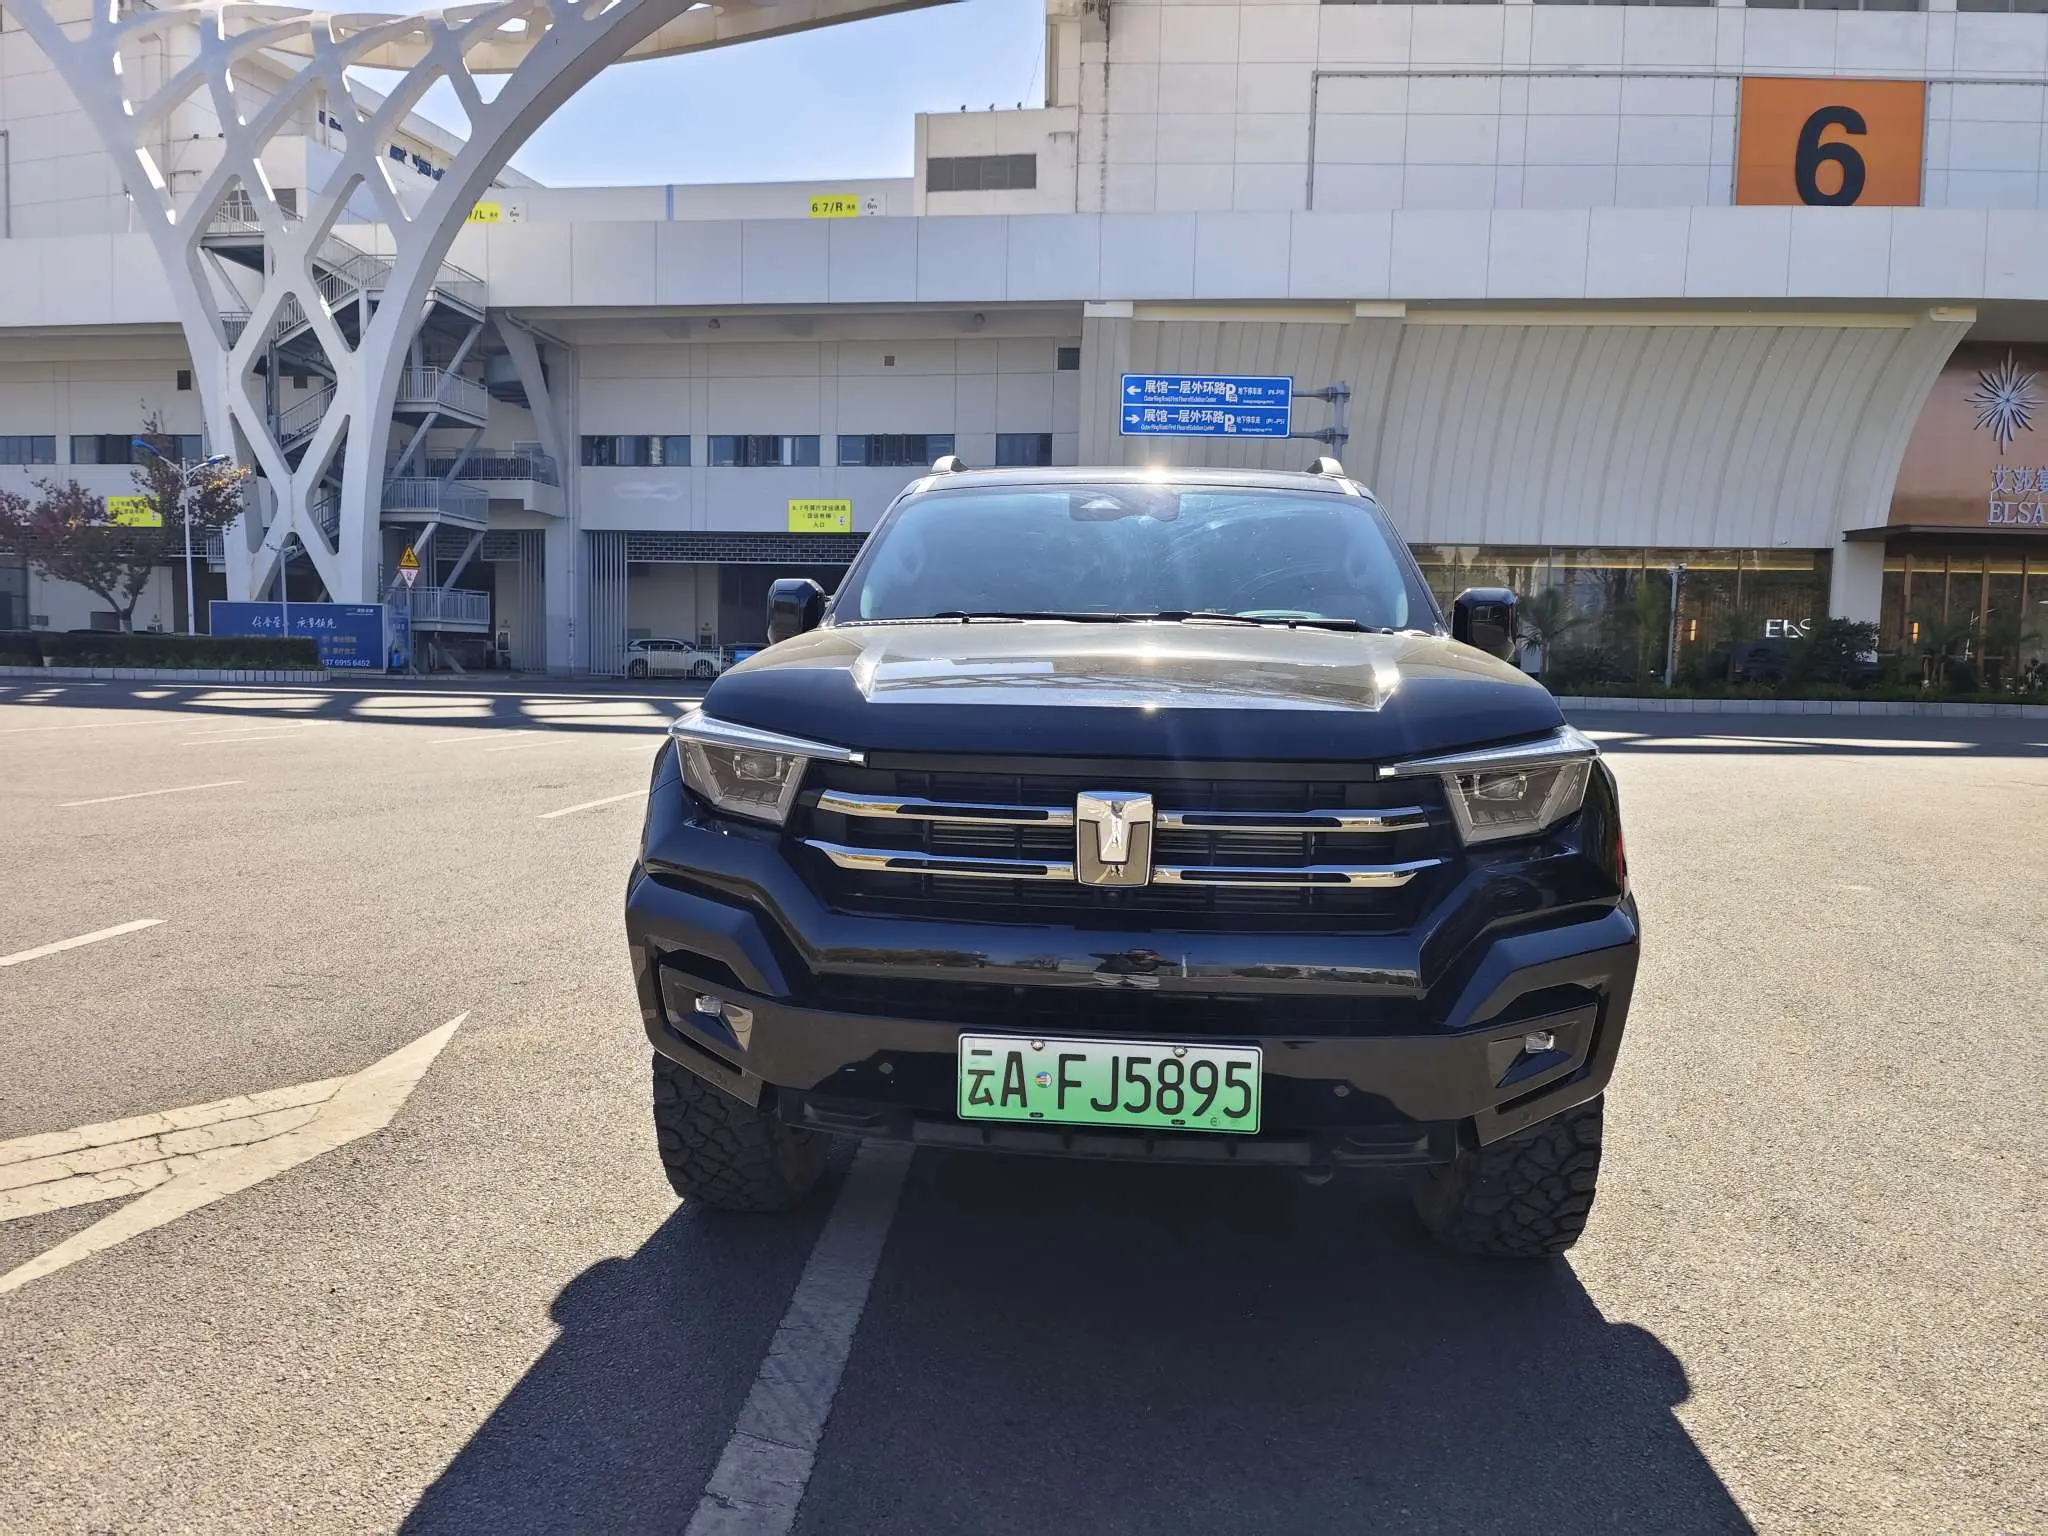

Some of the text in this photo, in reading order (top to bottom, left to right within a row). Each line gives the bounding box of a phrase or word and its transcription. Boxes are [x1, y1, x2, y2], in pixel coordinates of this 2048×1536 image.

[1794, 105, 1868, 206] 6
[1144, 379, 1226, 395] 展馆一层外环路
[1143, 408, 1224, 424] 展馆一层外环路
[1988, 500, 2048, 524] ELSA
